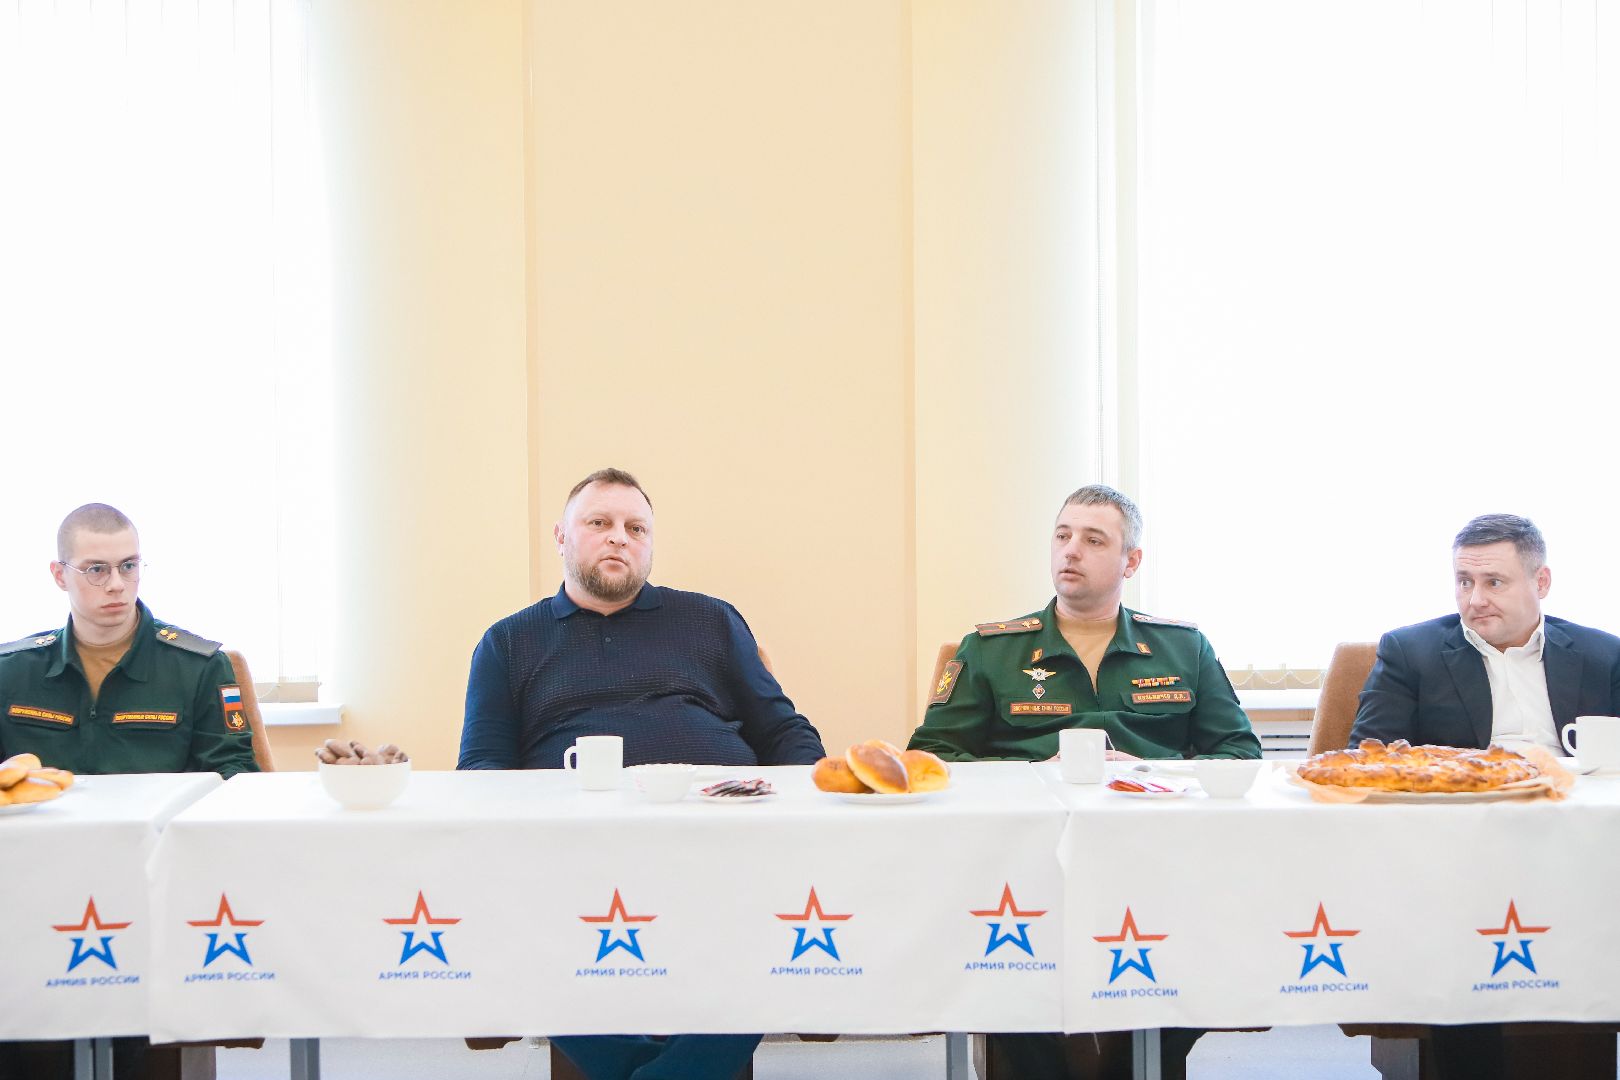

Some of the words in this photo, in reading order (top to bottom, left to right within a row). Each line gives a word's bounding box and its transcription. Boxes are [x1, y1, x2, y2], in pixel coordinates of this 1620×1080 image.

[965, 961, 1005, 970] АРМИЯ
[1008, 961, 1057, 970] РОССИИ
[379, 971, 419, 980] АРМИЯ
[423, 971, 472, 979] РОССИИ
[575, 968, 616, 977] АРМИЯ
[619, 968, 668, 976] РОССИИ
[770, 967, 811, 976] АРМИЯ
[814, 966, 864, 975] РОССИИ
[46, 977, 87, 987] АРМИЯ
[91, 975, 140, 985] РОССИИ
[184, 972, 224, 983] АРМИЯ
[227, 972, 276, 980] РОССИИ
[1280, 984, 1319, 993] АРМИЯ
[1322, 982, 1369, 991] РОССИИ
[1471, 982, 1510, 991] АРМИЯ
[1513, 979, 1560, 989] РОССИИ
[1092, 989, 1128, 998] АРМИЯ
[1130, 988, 1179, 997] РОССИИ
